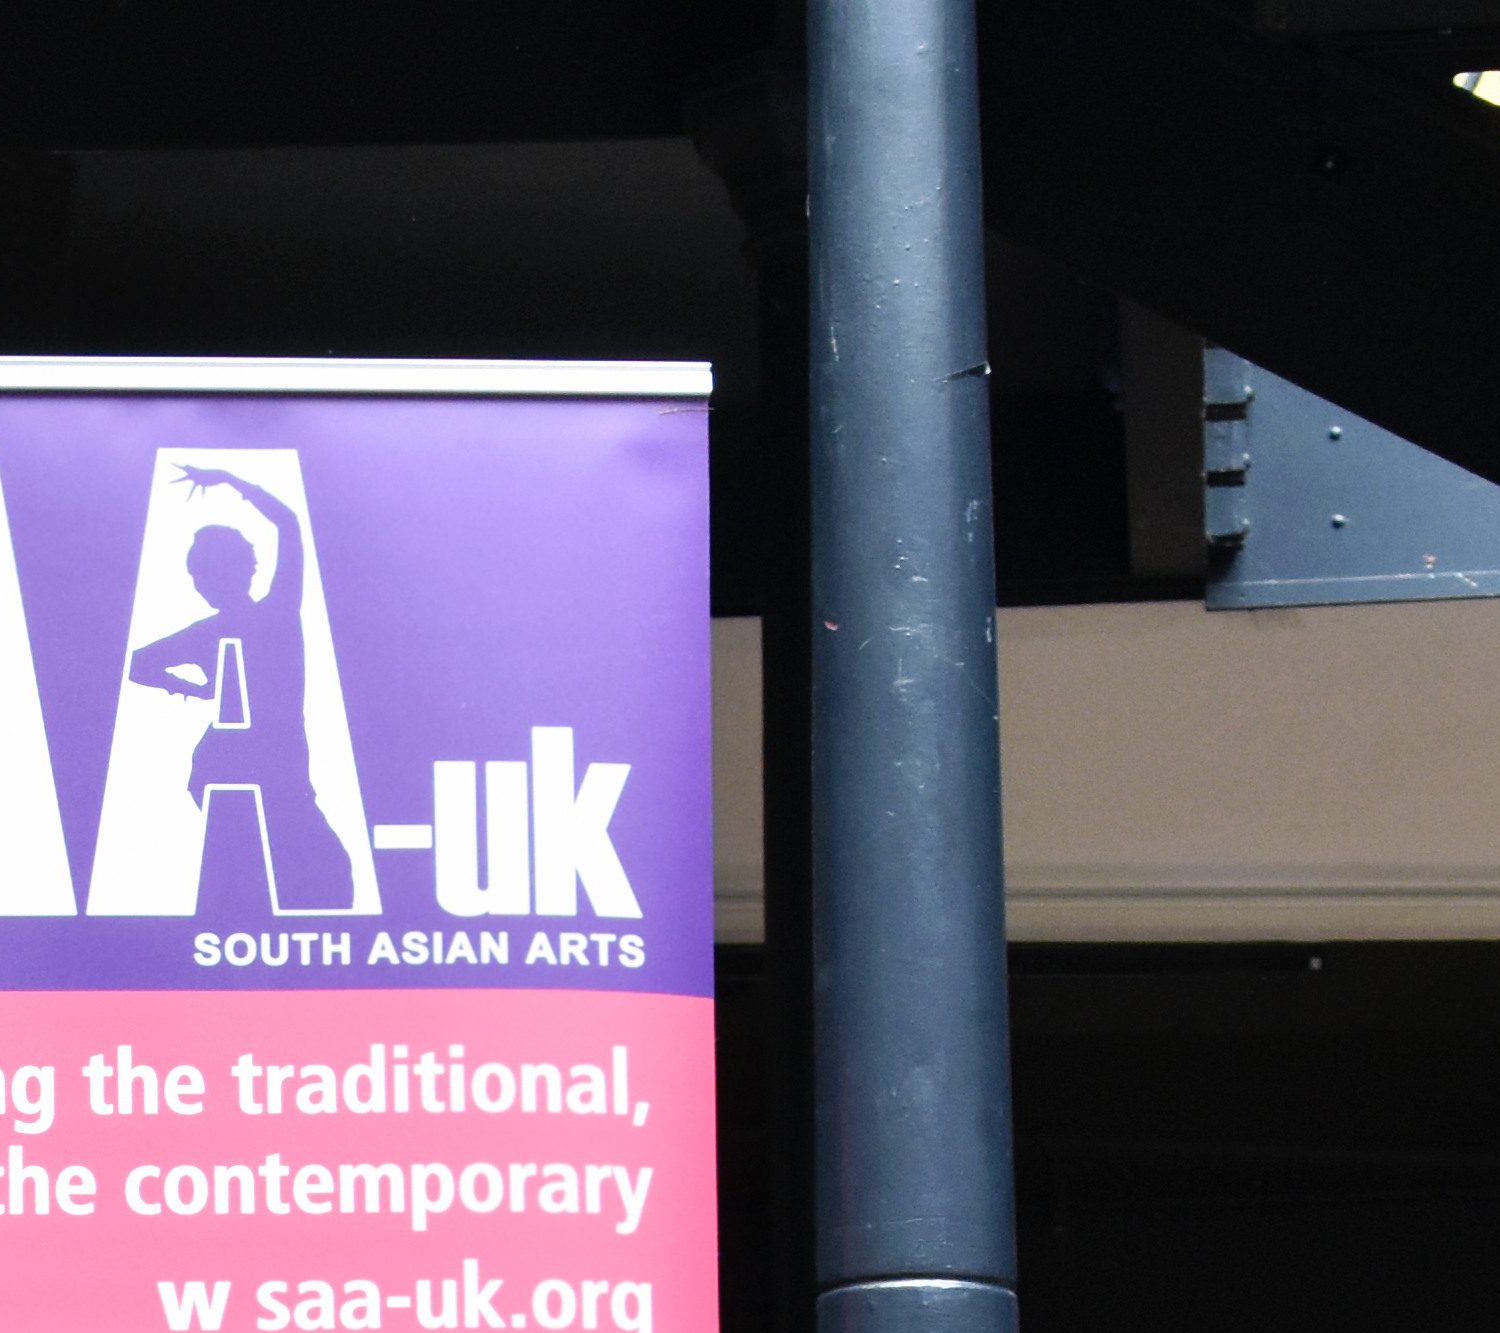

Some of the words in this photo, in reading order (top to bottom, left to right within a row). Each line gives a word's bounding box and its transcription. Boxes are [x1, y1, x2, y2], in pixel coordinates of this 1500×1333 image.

[193, 931, 352, 967] SOUTH
[366, 930, 510, 966] ASIAN
[524, 931, 646, 968] ARTS
[80, 1043, 207, 1117] the
[230, 1043, 651, 1128] traditional,
[123, 1151, 655, 1235] contemporary
[156, 1279, 233, 1332] w
